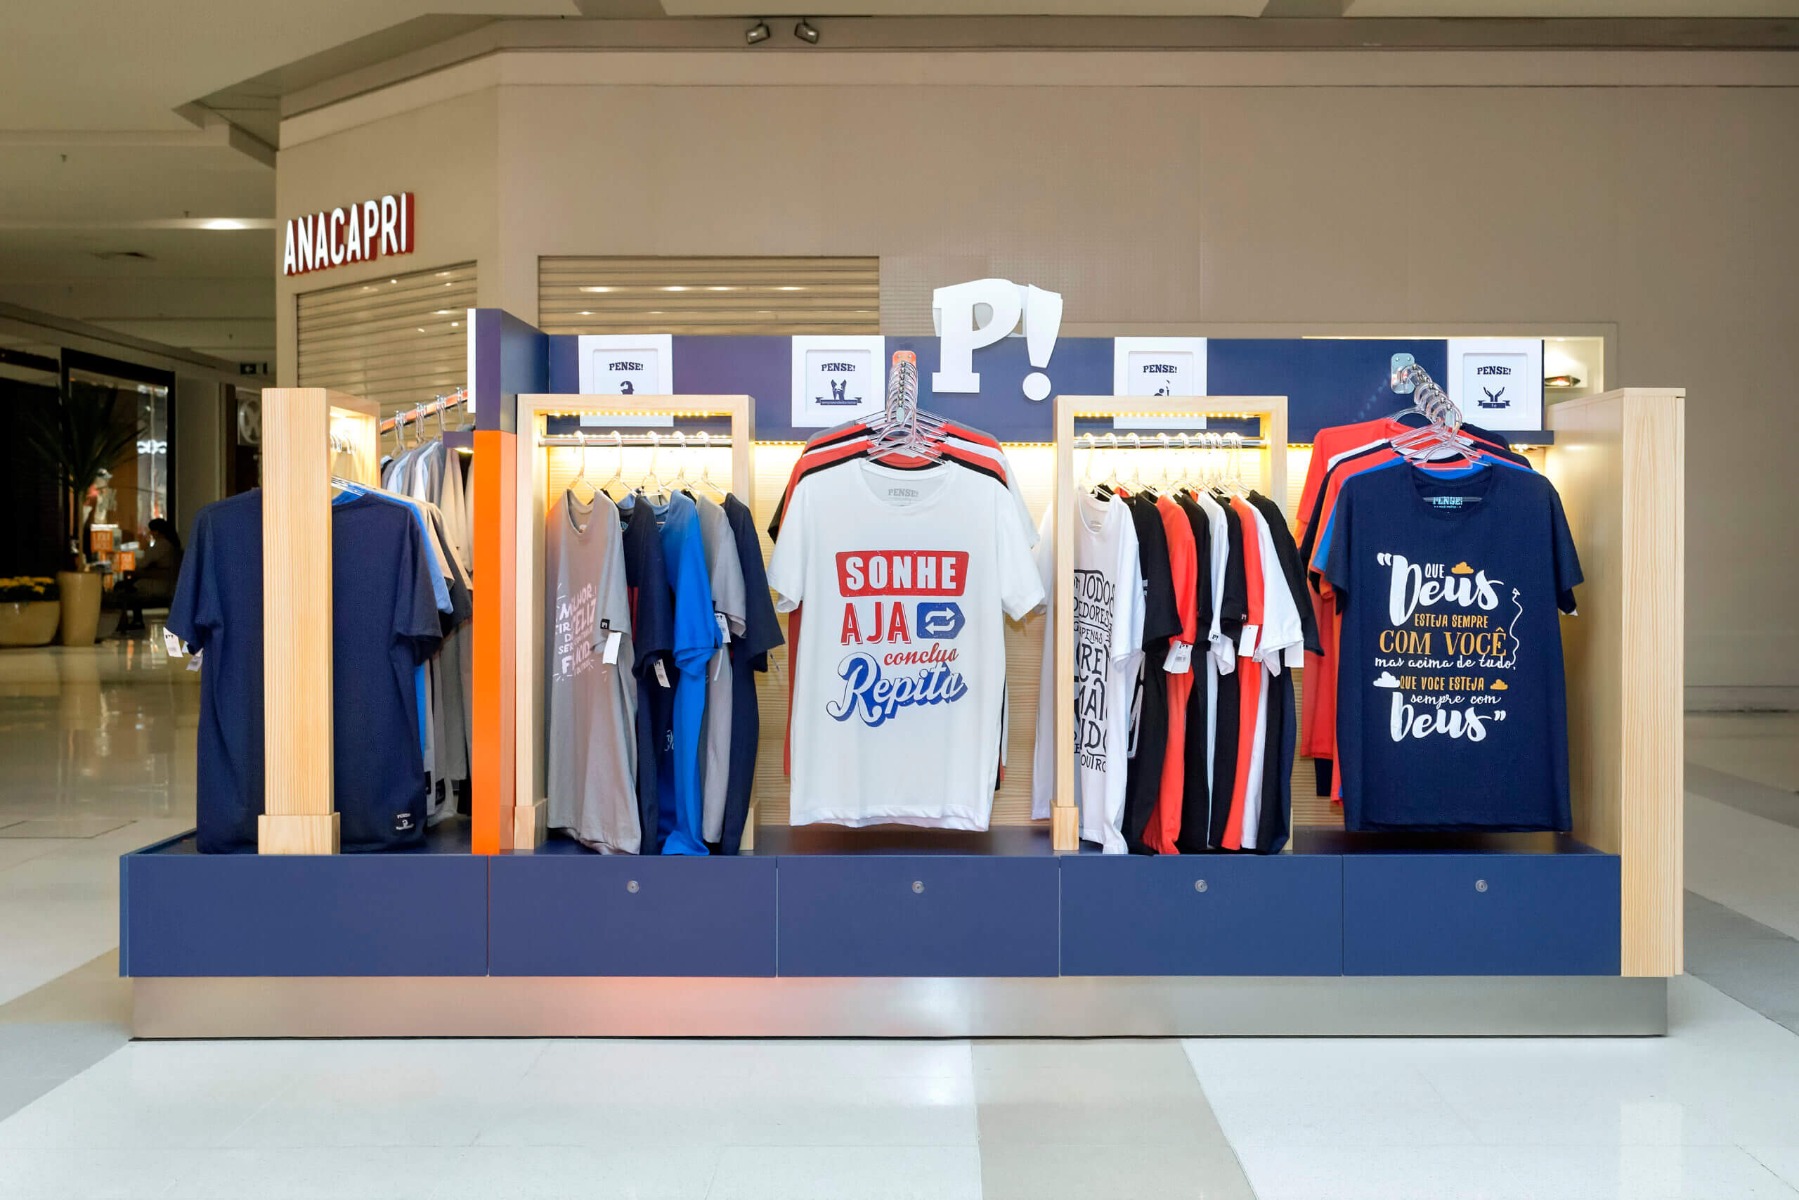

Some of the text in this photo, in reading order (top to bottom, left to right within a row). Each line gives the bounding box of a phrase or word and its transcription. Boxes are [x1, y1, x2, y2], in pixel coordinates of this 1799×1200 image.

[283, 191, 411, 276] ANACAPRI
[932, 278, 1063, 401] P!
[609, 361, 644, 371] PENSE!
[821, 362, 856, 372] PENSE!
[1143, 363, 1178, 374] PENSE!
[1477, 365, 1512, 376] PENSE!
[845, 555, 957, 591] SONHE
[1424, 563, 1445, 579] QUE
[840, 601, 911, 645] AJA
[1414, 613, 1489, 629] ESTEJA SEMPRE
[1379, 626, 1507, 657] COM VOCÊ
[883, 642, 959, 666] conclua
[1374, 657, 1405, 668] mas
[1407, 656, 1454, 669] acima
[1456, 654, 1477, 669] de
[826, 651, 968, 727] Repita
[1400, 675, 1417, 690] QUE
[1449, 676, 1485, 691] ESTEJA
[1410, 693, 1502, 710] sempre com
